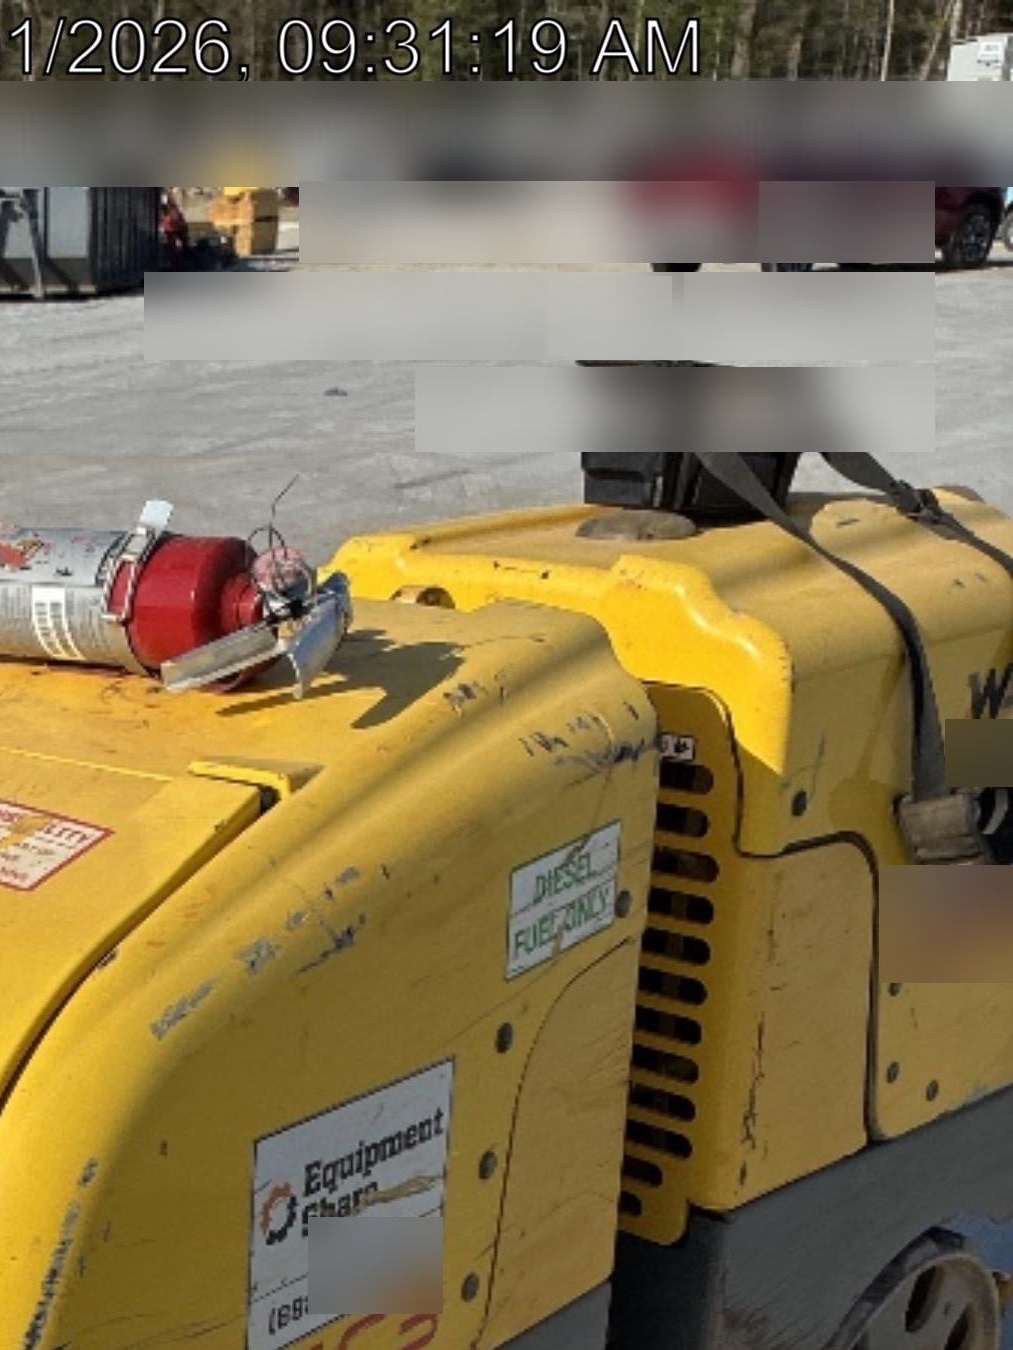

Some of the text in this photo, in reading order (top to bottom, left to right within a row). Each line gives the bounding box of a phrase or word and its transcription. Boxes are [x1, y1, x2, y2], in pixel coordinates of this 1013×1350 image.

[535, 851, 597, 901] DIESEL
[564, 886, 610, 931] ONLY
[303, 1106, 444, 1197] Equipment
